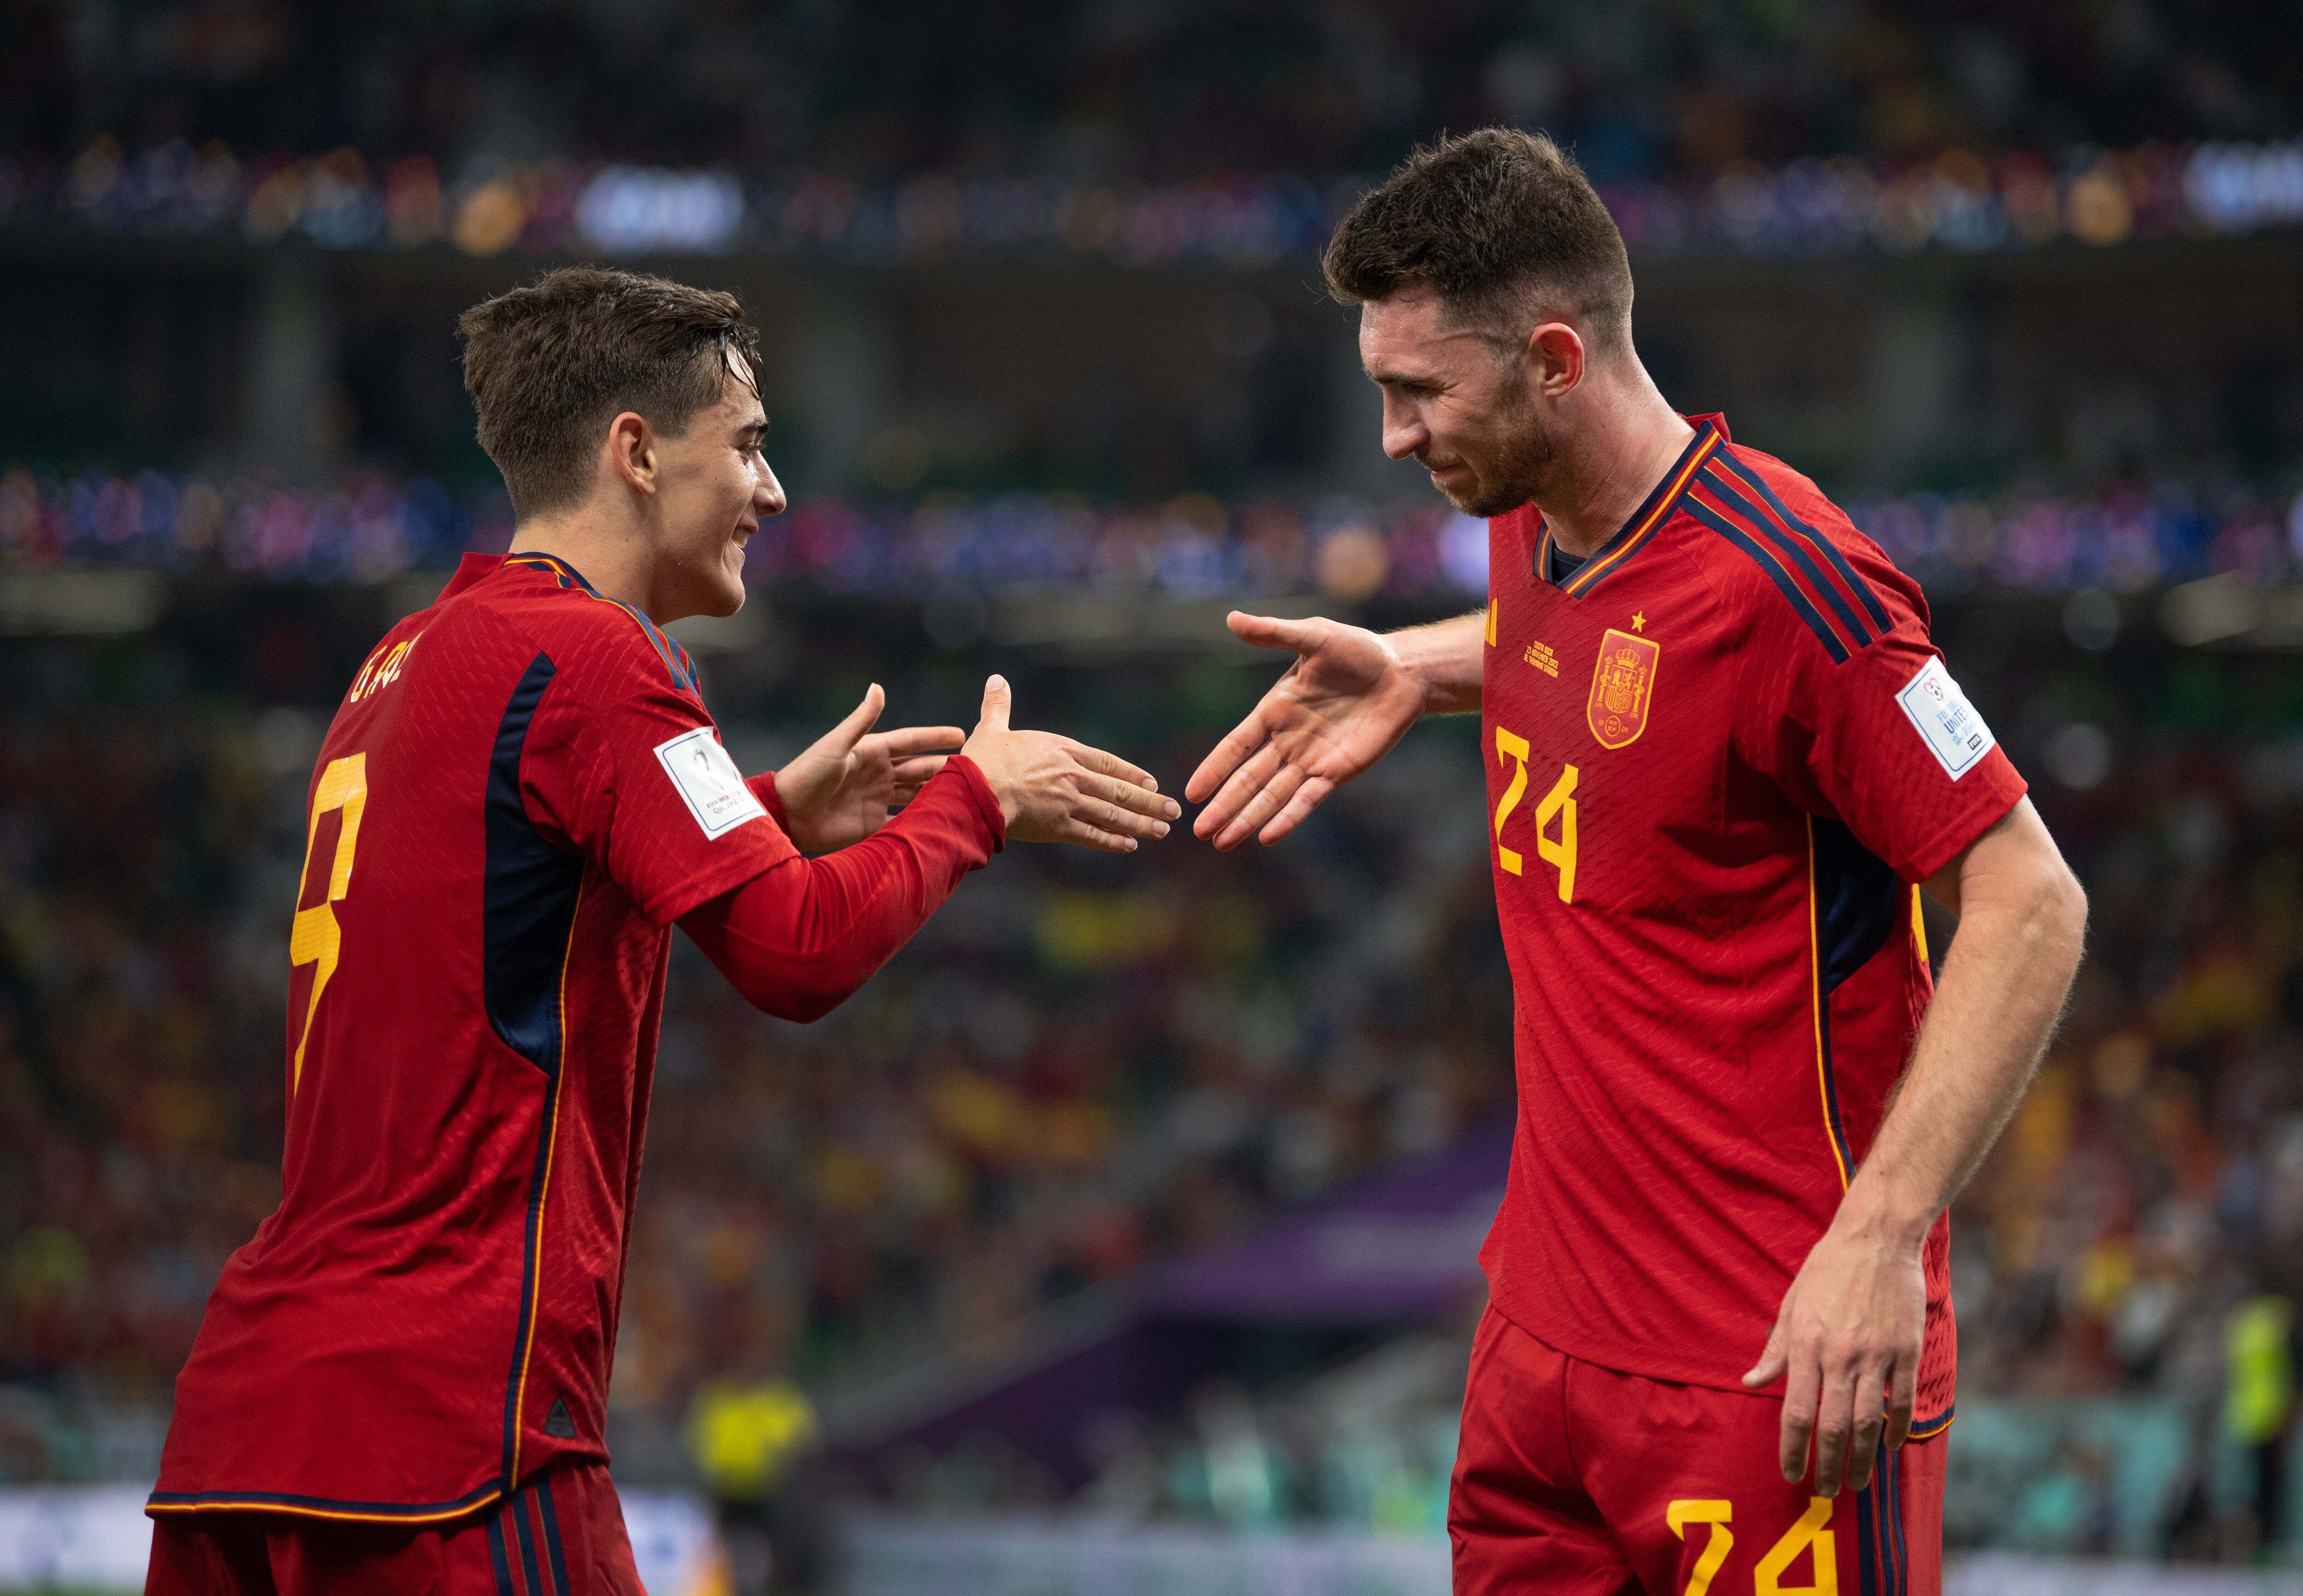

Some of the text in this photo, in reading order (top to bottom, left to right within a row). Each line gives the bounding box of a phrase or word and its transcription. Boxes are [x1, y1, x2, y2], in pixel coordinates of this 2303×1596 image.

[1526, 646, 1531, 654] 23
[1548, 658, 1559, 669] 2022
[1544, 646, 1553, 657] RICA
[1944, 706, 1969, 734] UNITES
[1969, 735, 1982, 749] FIFA
[707, 800, 719, 809] FIFA
[1495, 726, 1578, 904] 24
[290, 751, 367, 1100] 9
